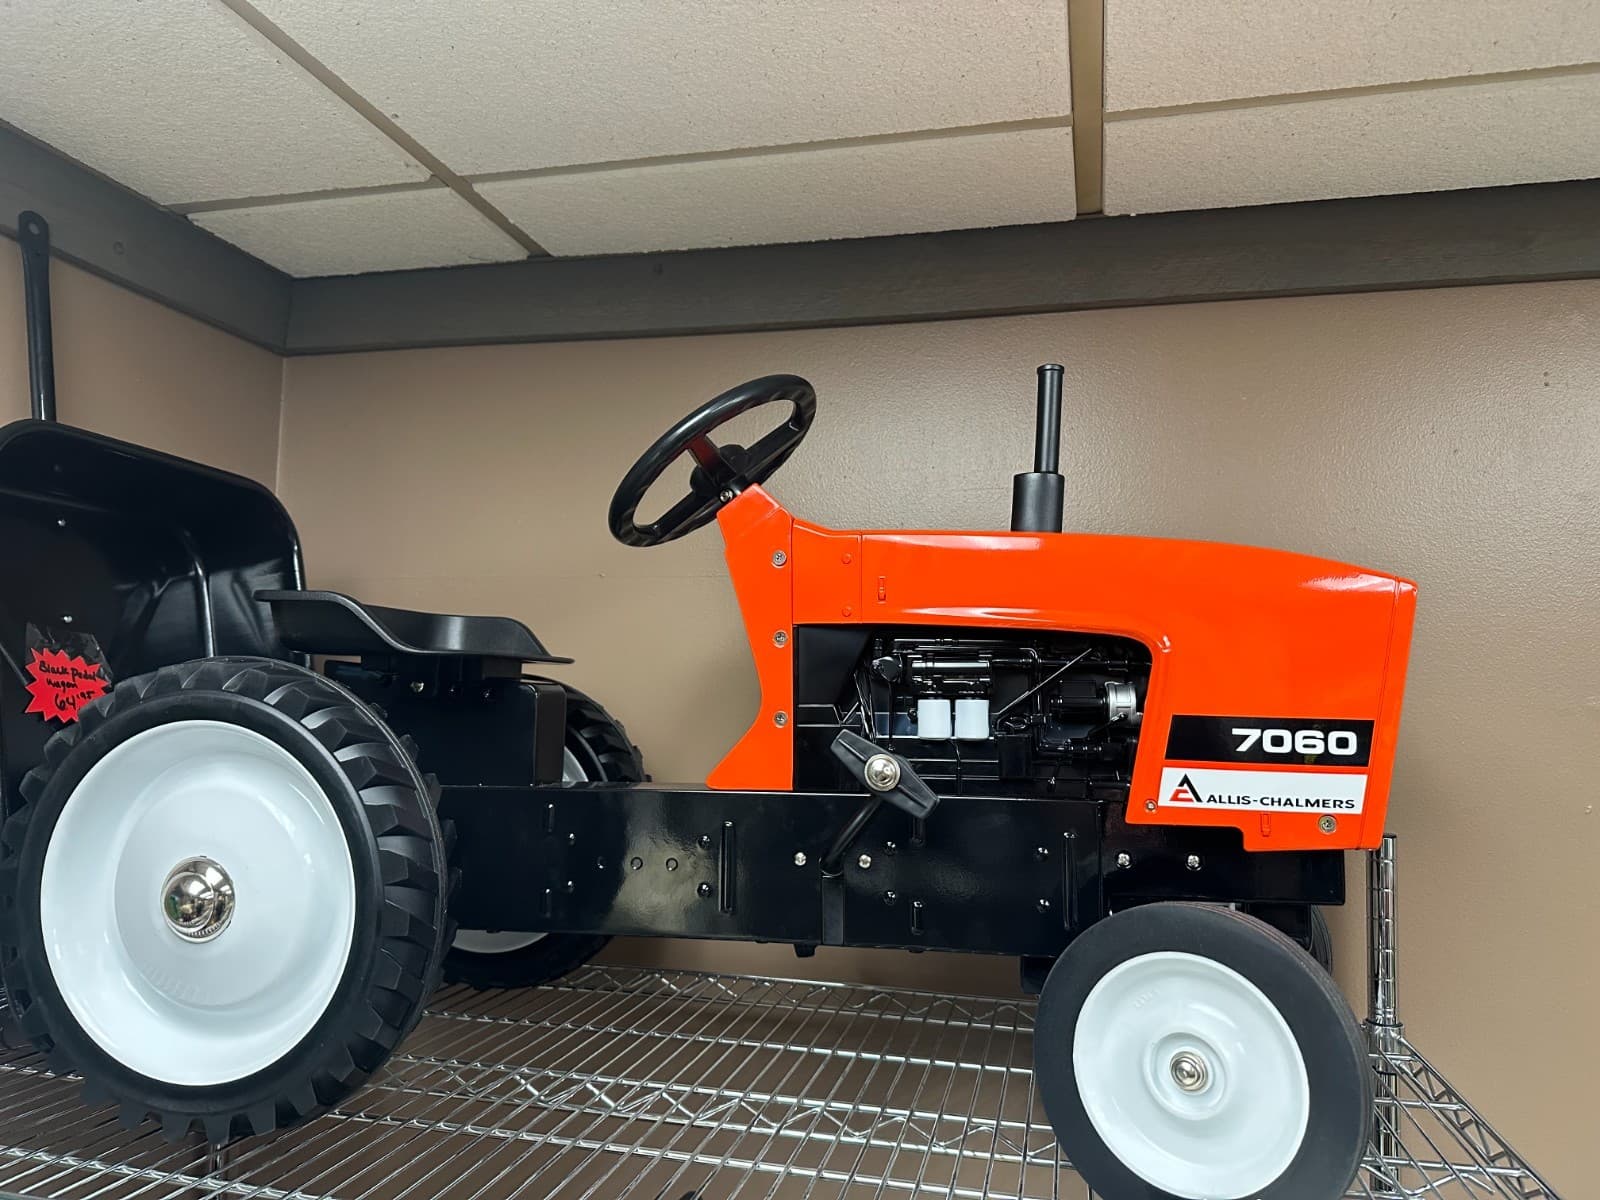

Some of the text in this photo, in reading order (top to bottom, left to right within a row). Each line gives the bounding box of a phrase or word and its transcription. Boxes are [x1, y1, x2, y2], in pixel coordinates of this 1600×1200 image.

[39, 660, 97, 682] Black Pedal
[1231, 727, 1358, 756] 7060
[1206, 793, 1356, 810] ALLIS-CHALMERS
